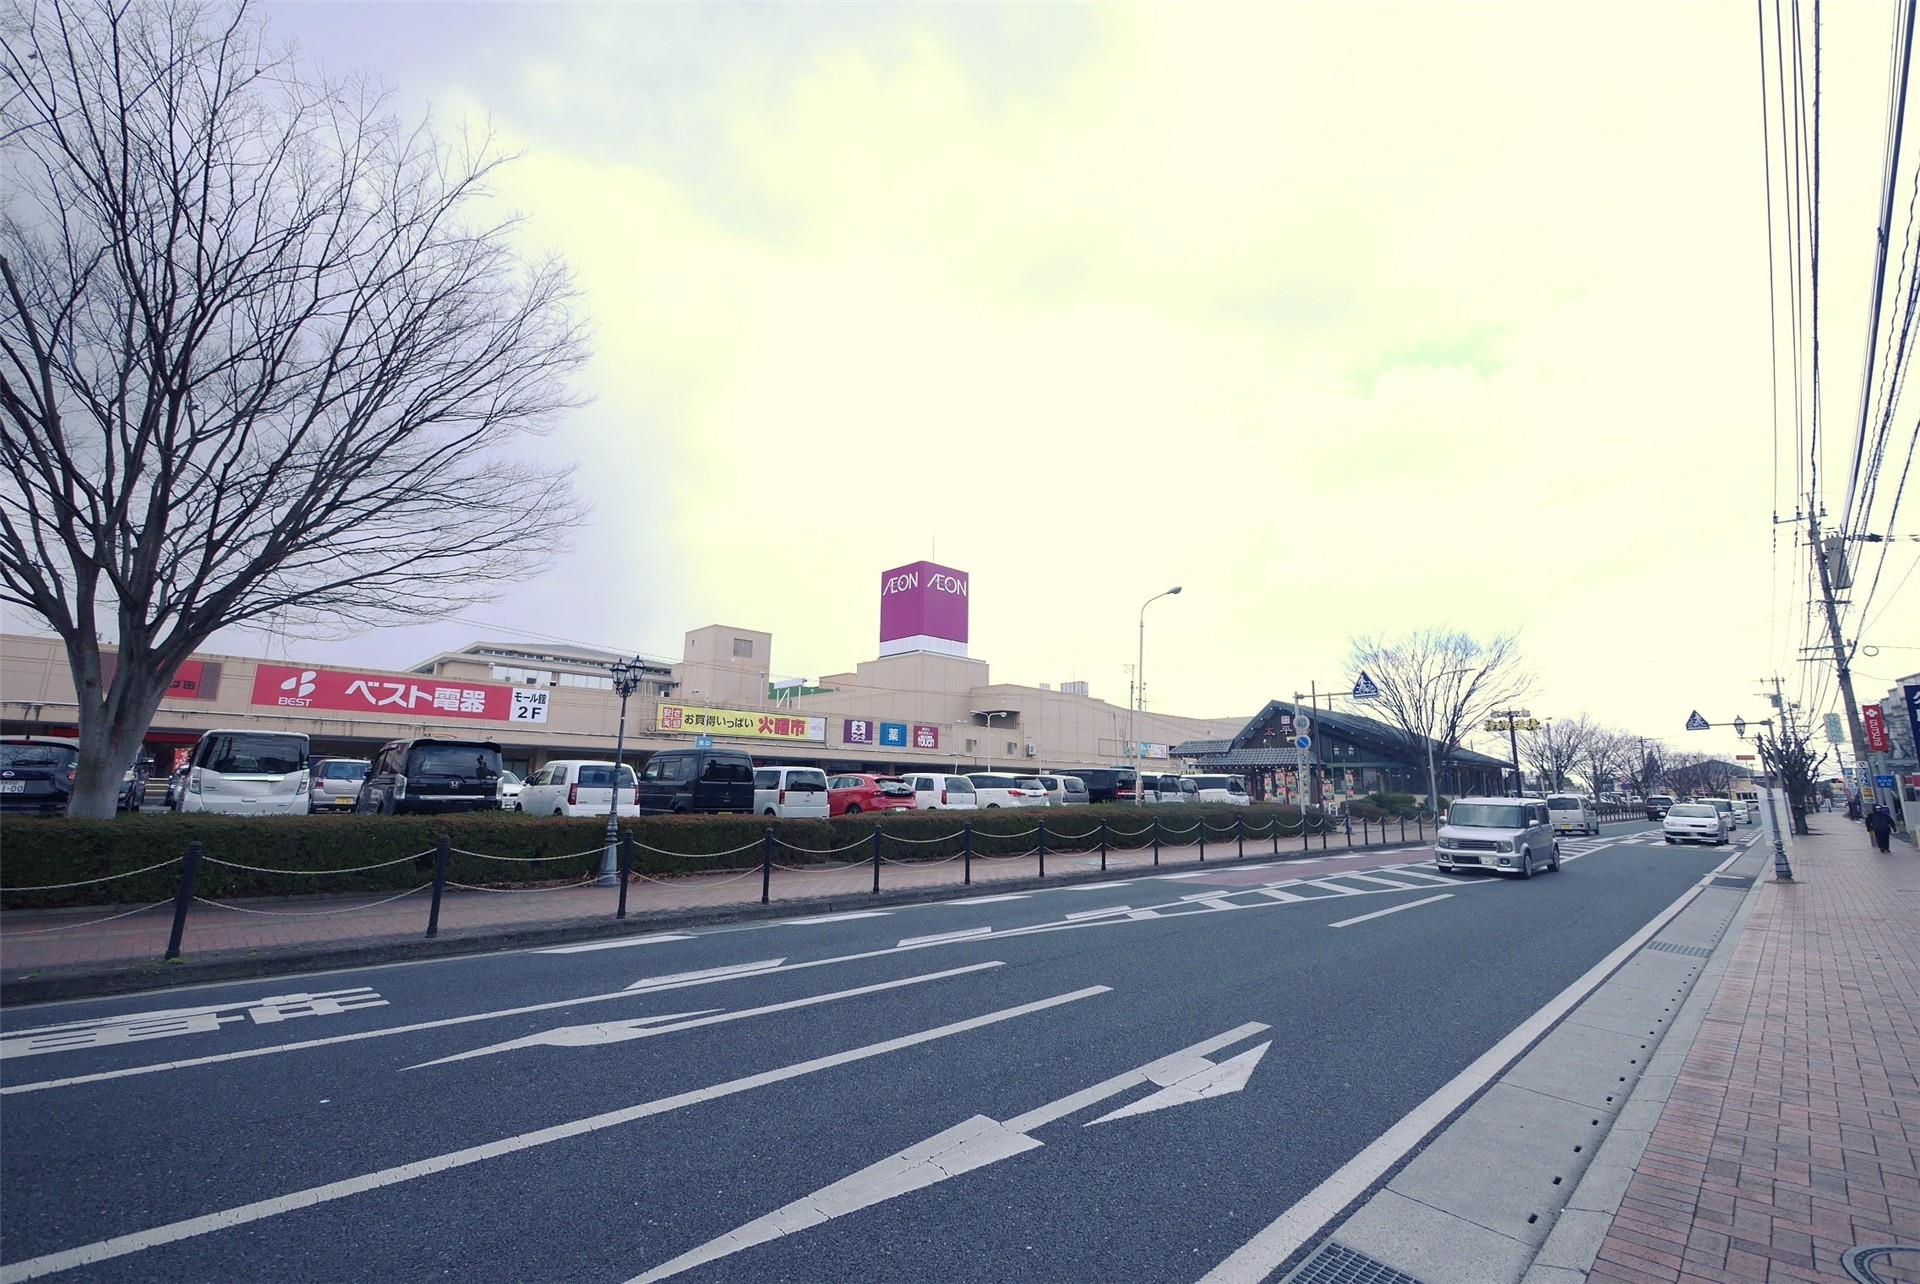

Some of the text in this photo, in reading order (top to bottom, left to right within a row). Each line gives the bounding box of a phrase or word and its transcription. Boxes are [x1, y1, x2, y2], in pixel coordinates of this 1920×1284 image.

[278, 697, 313, 707] BEST
[344, 680, 486, 713] ベスト電器
[514, 692, 547, 705] モール館
[517, 706, 542, 719] 2F
[684, 713, 754, 728] お買得いっぱい
[758, 716, 806, 736] 火曜市
